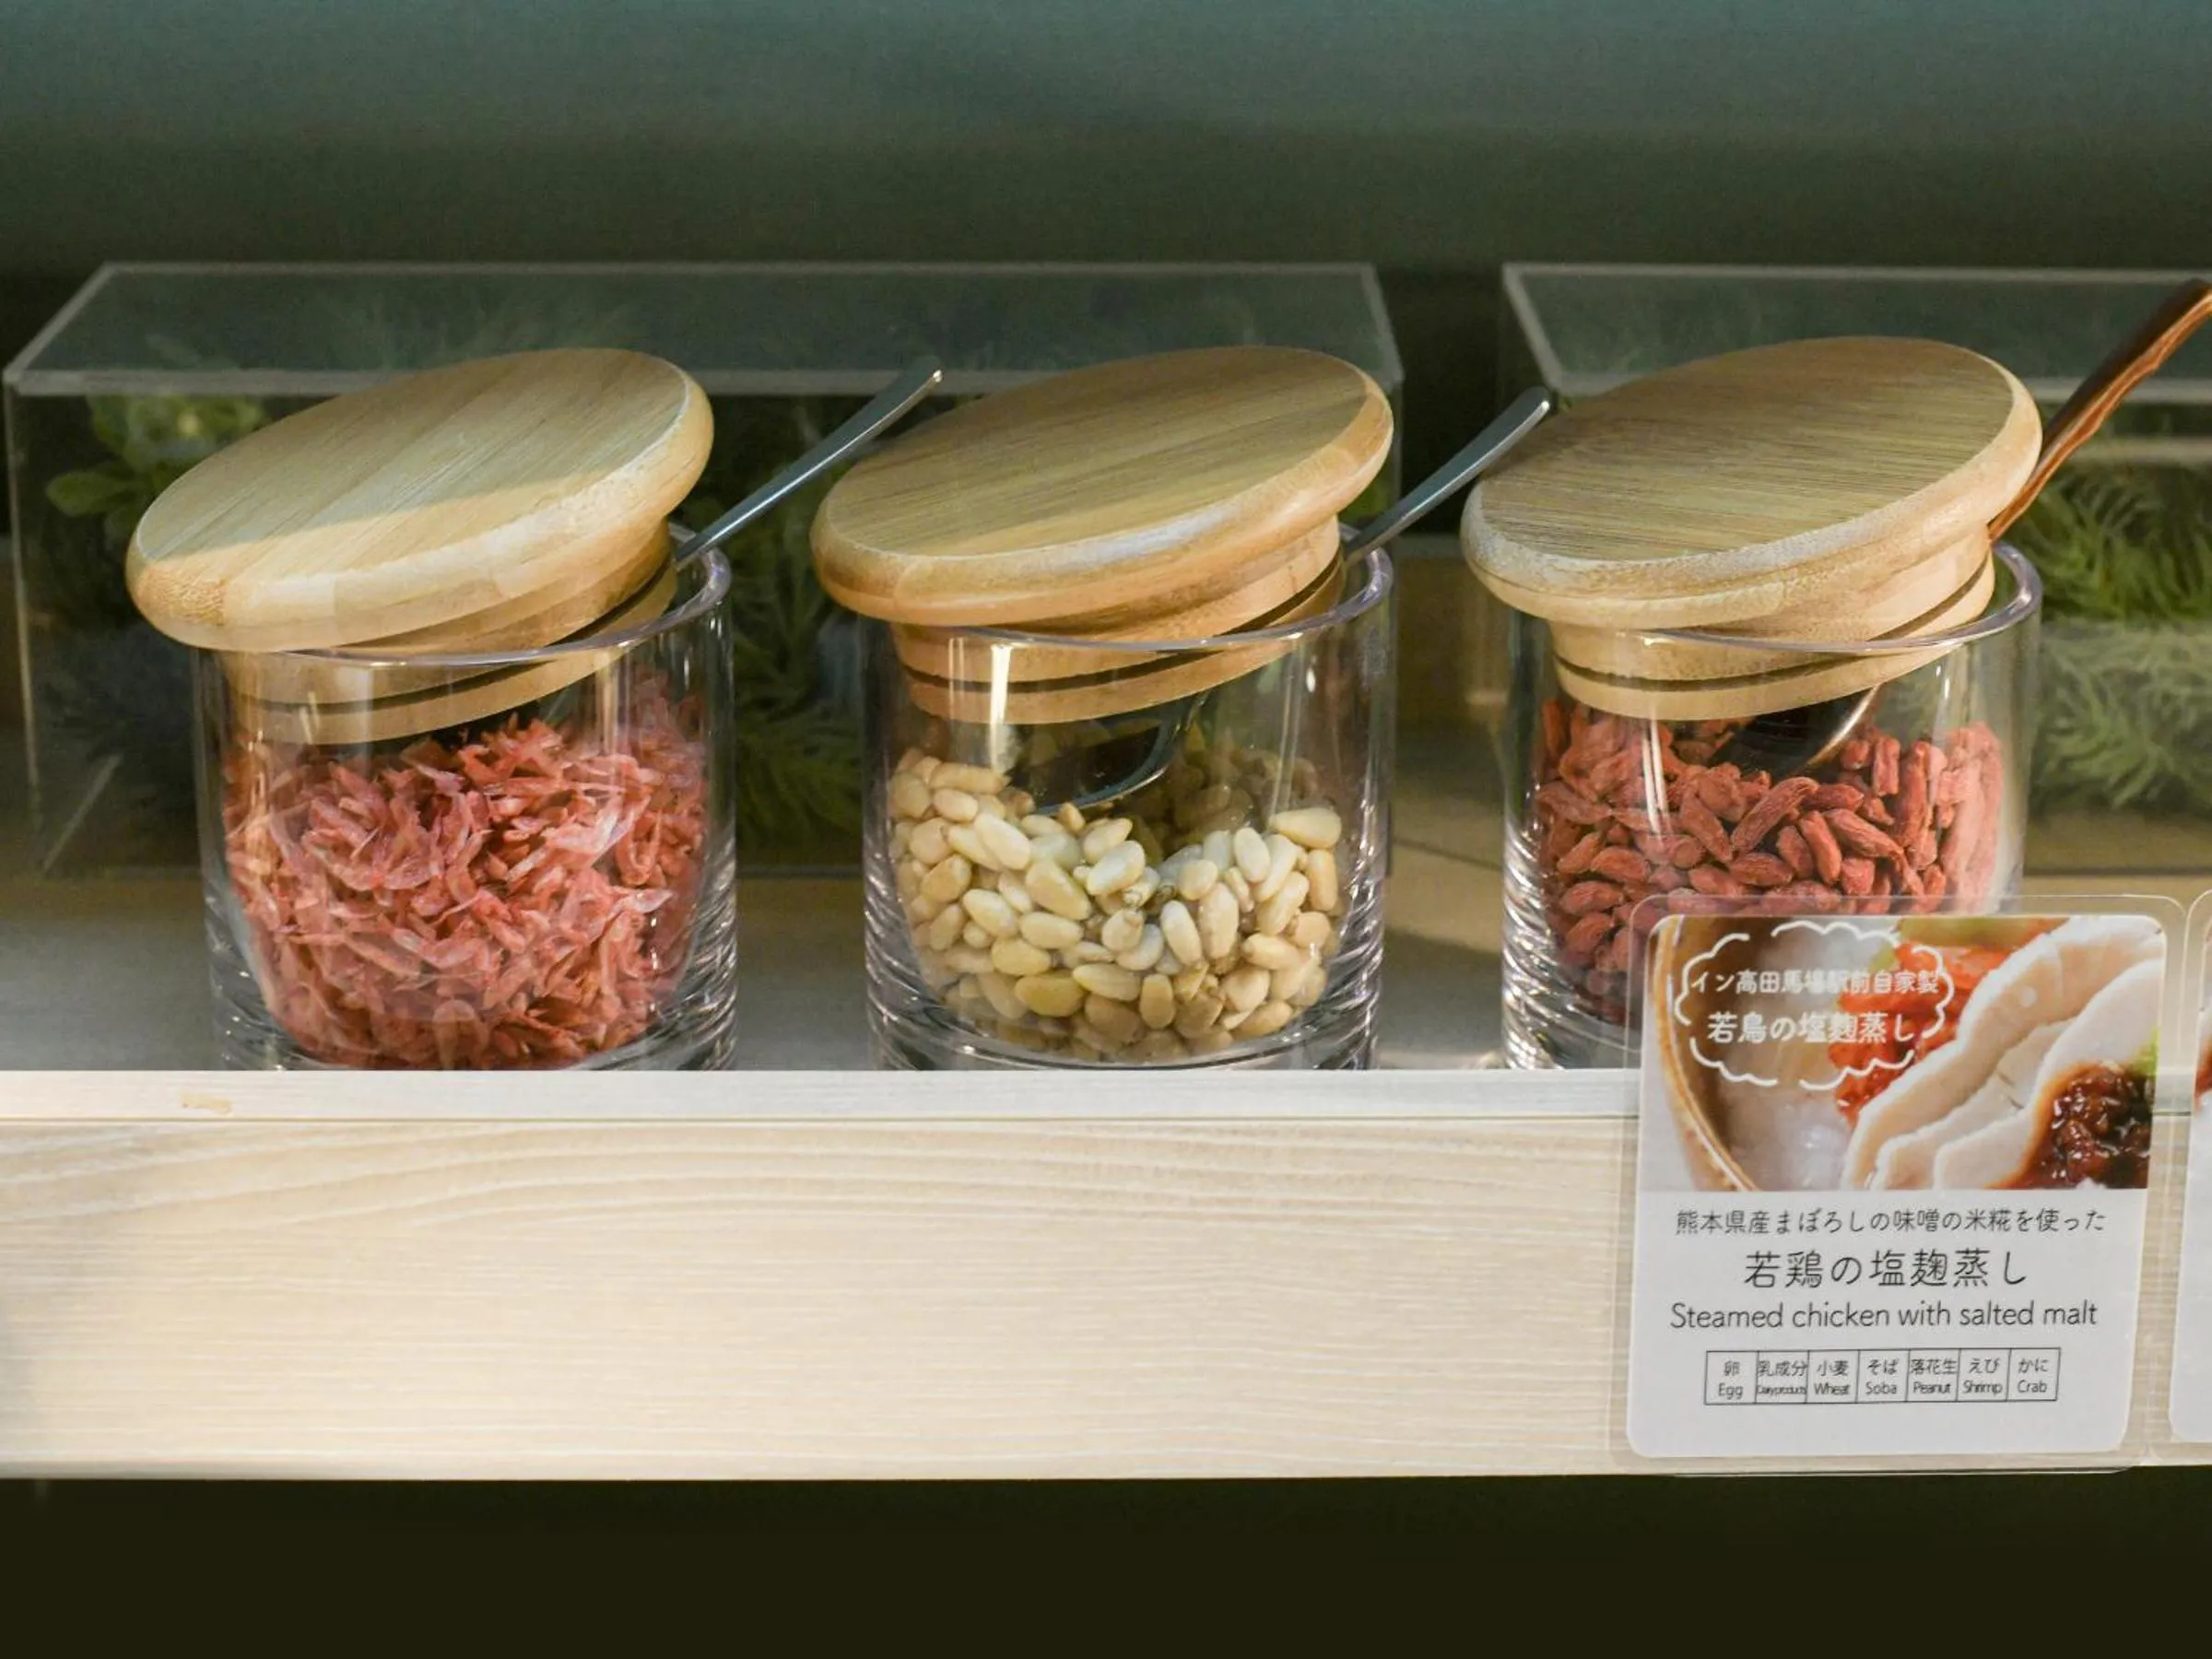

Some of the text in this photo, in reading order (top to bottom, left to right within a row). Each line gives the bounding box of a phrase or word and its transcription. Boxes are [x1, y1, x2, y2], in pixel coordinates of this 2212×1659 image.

[1670, 1300, 2098, 1328] Steamed chicken with salted malt
[1723, 1360, 1740, 1377] 卵
[1817, 1359, 1849, 1377] 小麦
[1867, 1359, 1897, 1375] そば
[1911, 1359, 1957, 1375] 落花生
[1969, 1359, 1999, 1374] えび
[2018, 1358, 2048, 1372] かに
[1719, 1385, 1743, 1399] Egg
[1814, 1383, 1850, 1395] Wheat
[1866, 1382, 1897, 1395] Soba
[1913, 1382, 1951, 1394] Peanut
[2018, 1380, 2047, 1394] Crab
